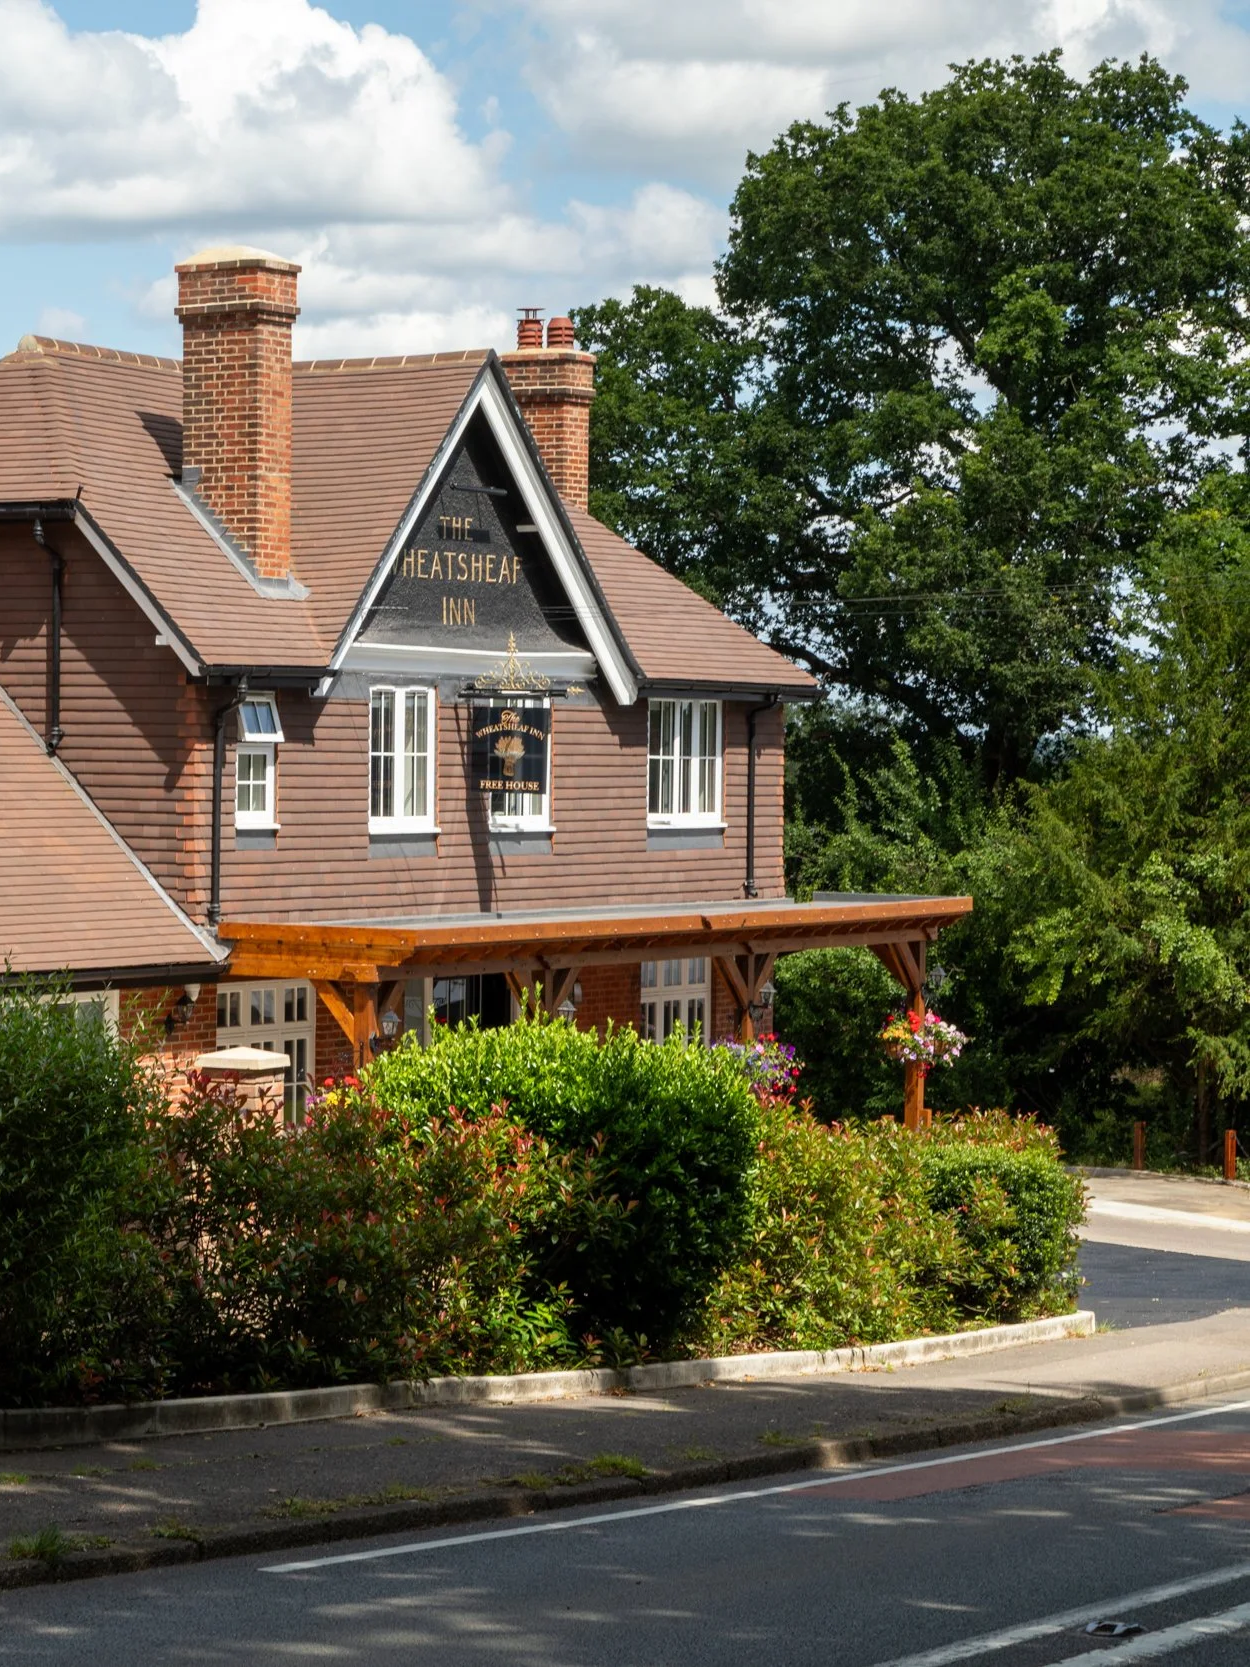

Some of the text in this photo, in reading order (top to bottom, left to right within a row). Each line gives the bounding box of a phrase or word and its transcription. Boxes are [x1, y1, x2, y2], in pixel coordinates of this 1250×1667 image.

[439, 516, 474, 541] THE
[442, 596, 476, 626] INN
[501, 710, 520, 724] The
[476, 723, 545, 740] WHEATSHEAF INN
[480, 780, 540, 791] FREE HOUSE
